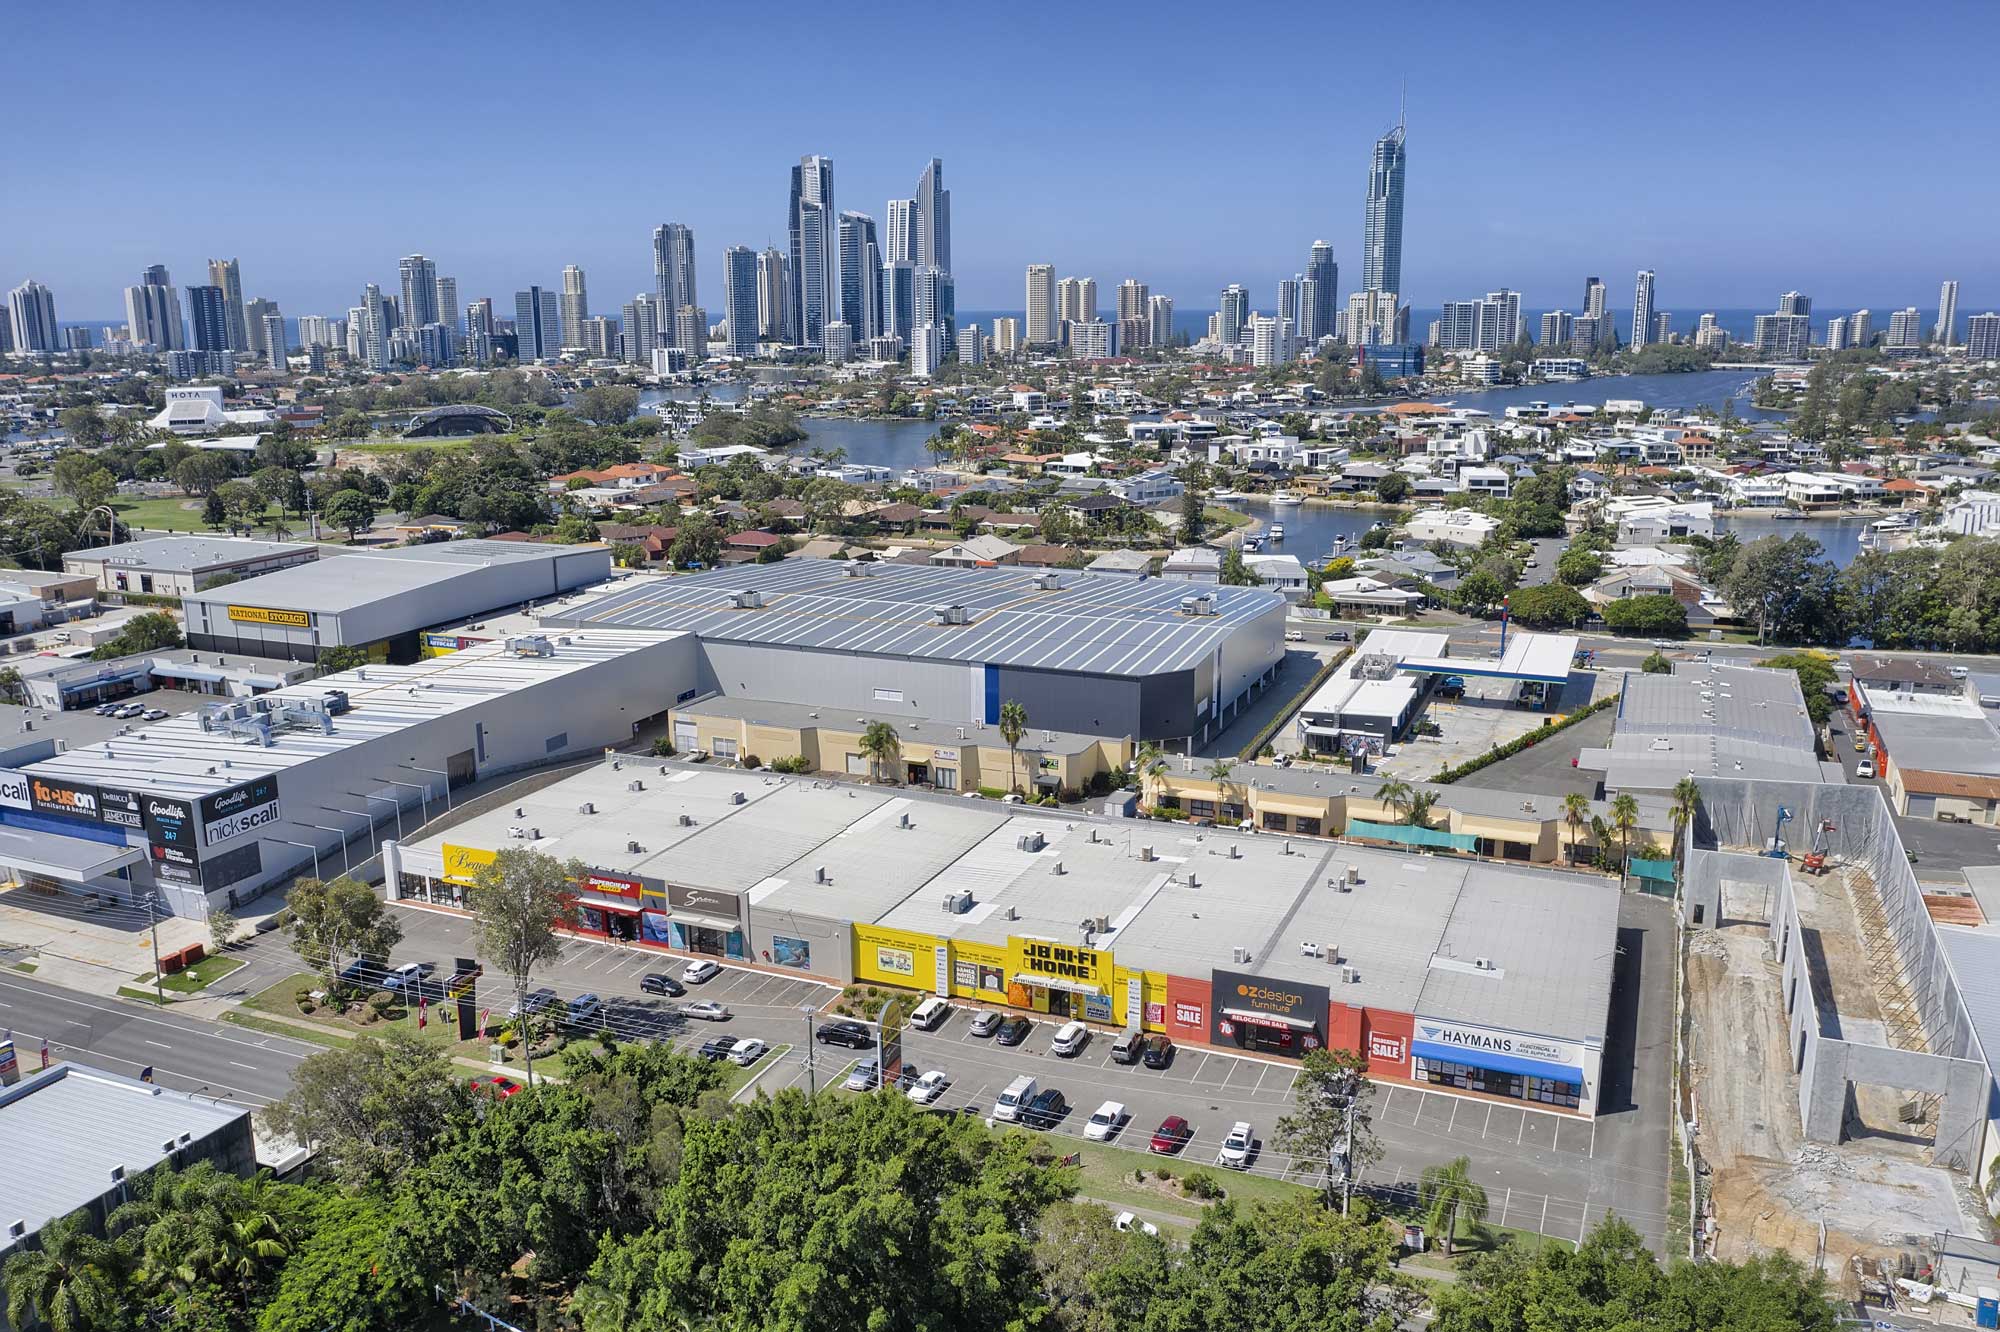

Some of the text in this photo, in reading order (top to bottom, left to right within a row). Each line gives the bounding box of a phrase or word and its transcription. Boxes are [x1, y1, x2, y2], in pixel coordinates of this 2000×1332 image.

[230, 609, 305, 623] NATIONAL STORAGE
[37, 800, 65, 811] furniture
[71, 806, 97, 817] bedding
[103, 811, 142, 825] JAMES LANE
[208, 801, 279, 843] nickscali
[589, 878, 631, 891] SUPERCHEAP
[1023, 944, 1051, 959] JB
[1030, 958, 1089, 979] HOME
[1250, 998, 1290, 1013] furniture
[1176, 1009, 1201, 1024] SALE
[1231, 1014, 1288, 1030] RELOCATION SALE
[1442, 1029, 1512, 1052] HAYMANS
[1519, 1043, 1550, 1052] ELECTRICAL
[1372, 1043, 1399, 1058] SALE
[1530, 1049, 1559, 1060] SUPPLIERS
